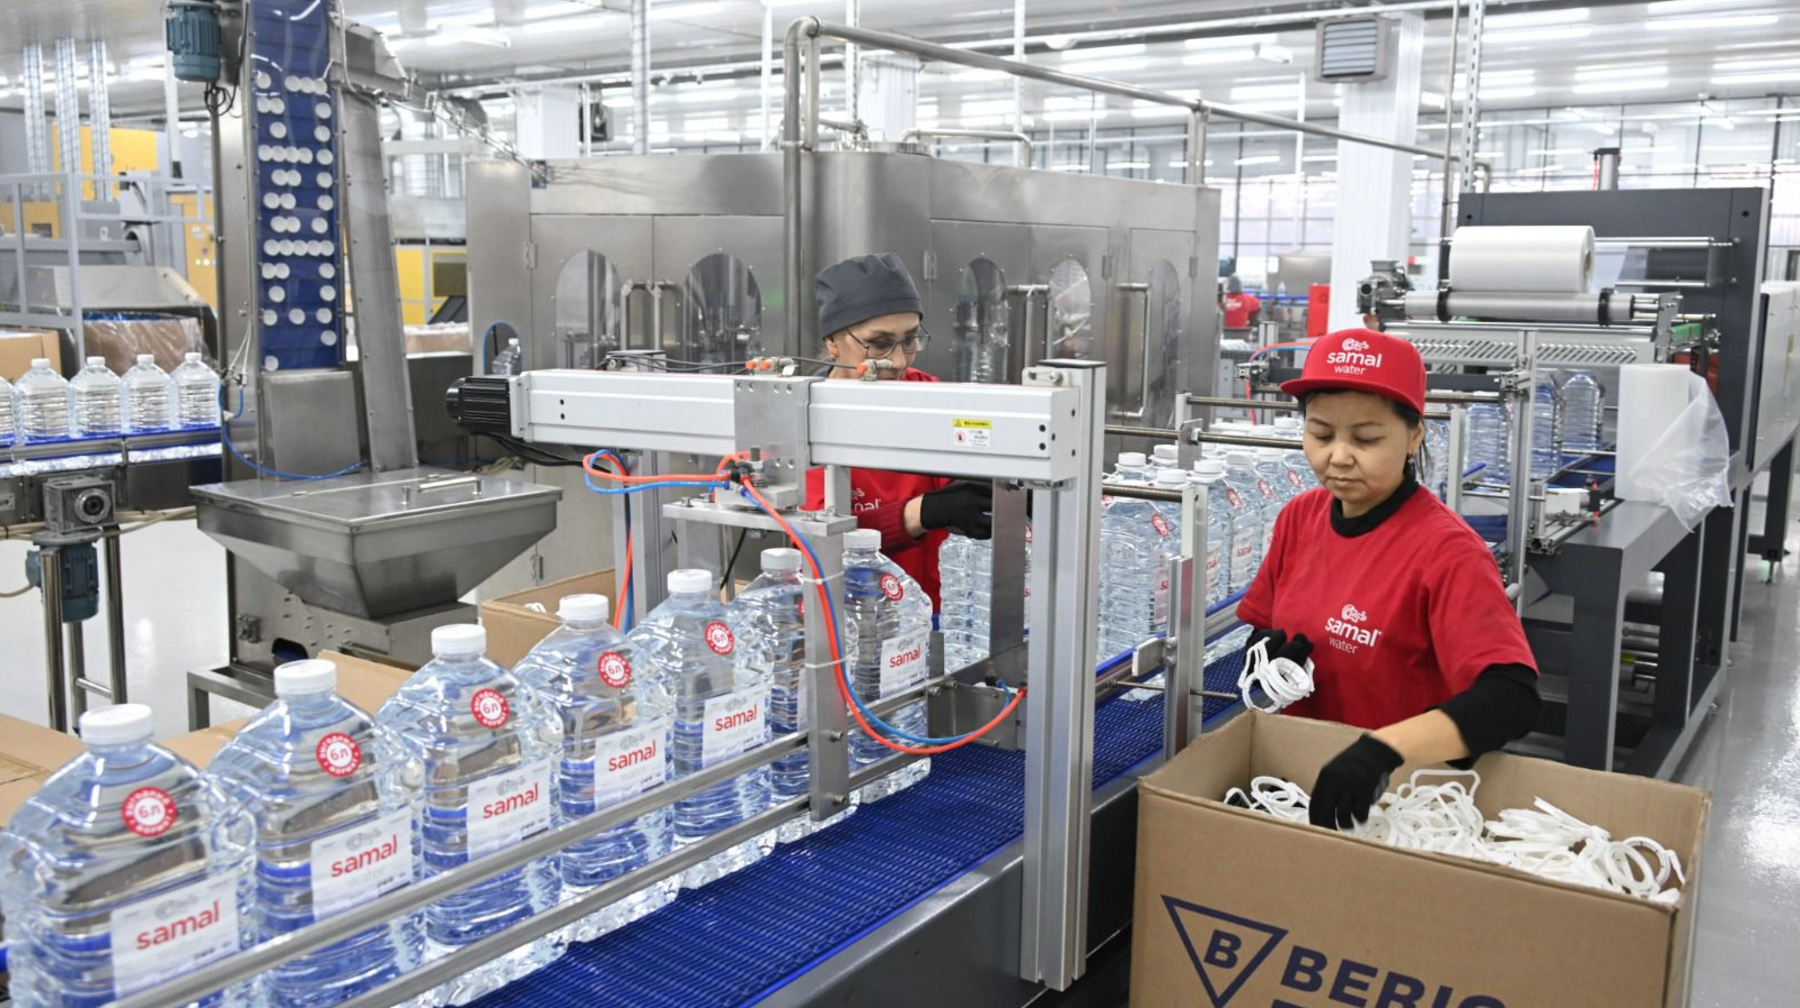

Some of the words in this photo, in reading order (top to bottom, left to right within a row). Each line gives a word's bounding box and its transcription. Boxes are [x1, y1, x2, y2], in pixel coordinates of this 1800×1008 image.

[1326, 351, 1383, 368] samal
[1334, 364, 1367, 375] water
[714, 633, 727, 643] 6л
[1325, 617, 1379, 647] samal
[889, 645, 921, 668] samal
[1328, 636, 1358, 654] water
[608, 665, 622, 675] 6л
[483, 702, 499, 714] 6л
[715, 703, 758, 731] samal
[330, 748, 350, 761] 6л
[608, 740, 656, 772] samal
[139, 804, 161, 819] 6л
[482, 782, 538, 819] samal
[331, 834, 397, 878] samal
[136, 899, 219, 951] samal
[1203, 929, 1242, 969] B
[1280, 945, 1507, 1008] BERI
